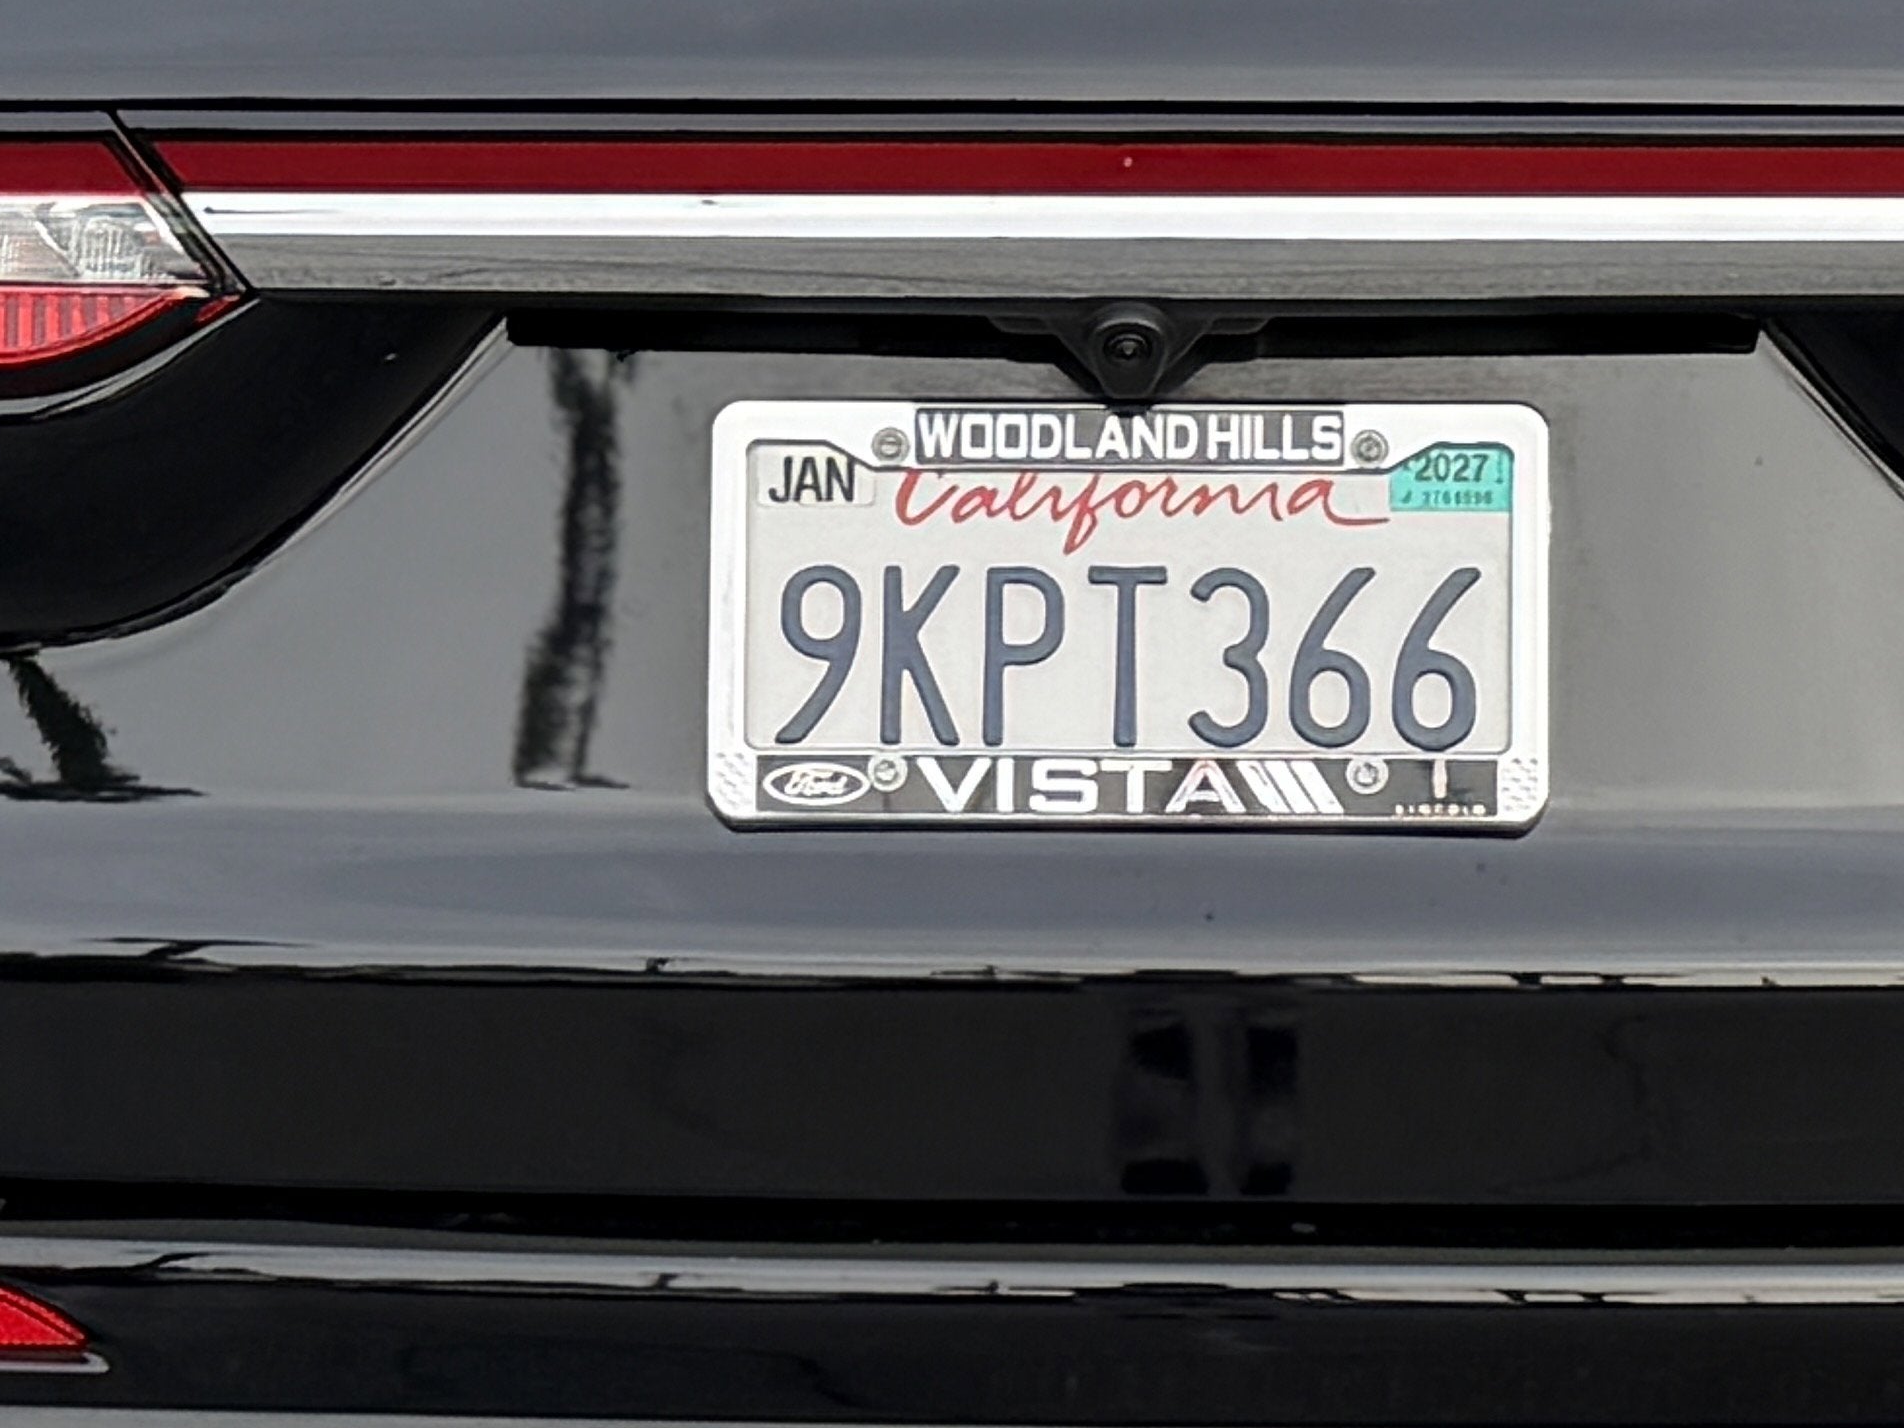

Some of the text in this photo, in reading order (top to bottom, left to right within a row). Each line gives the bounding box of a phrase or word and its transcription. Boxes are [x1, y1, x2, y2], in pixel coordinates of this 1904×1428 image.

[918, 413, 1344, 461] WOODLAND HILLS
[768, 456, 856, 503] JAN
[1414, 453, 1489, 483] 2027
[895, 470, 1391, 555] California
[774, 564, 1482, 751] 9KPT366
